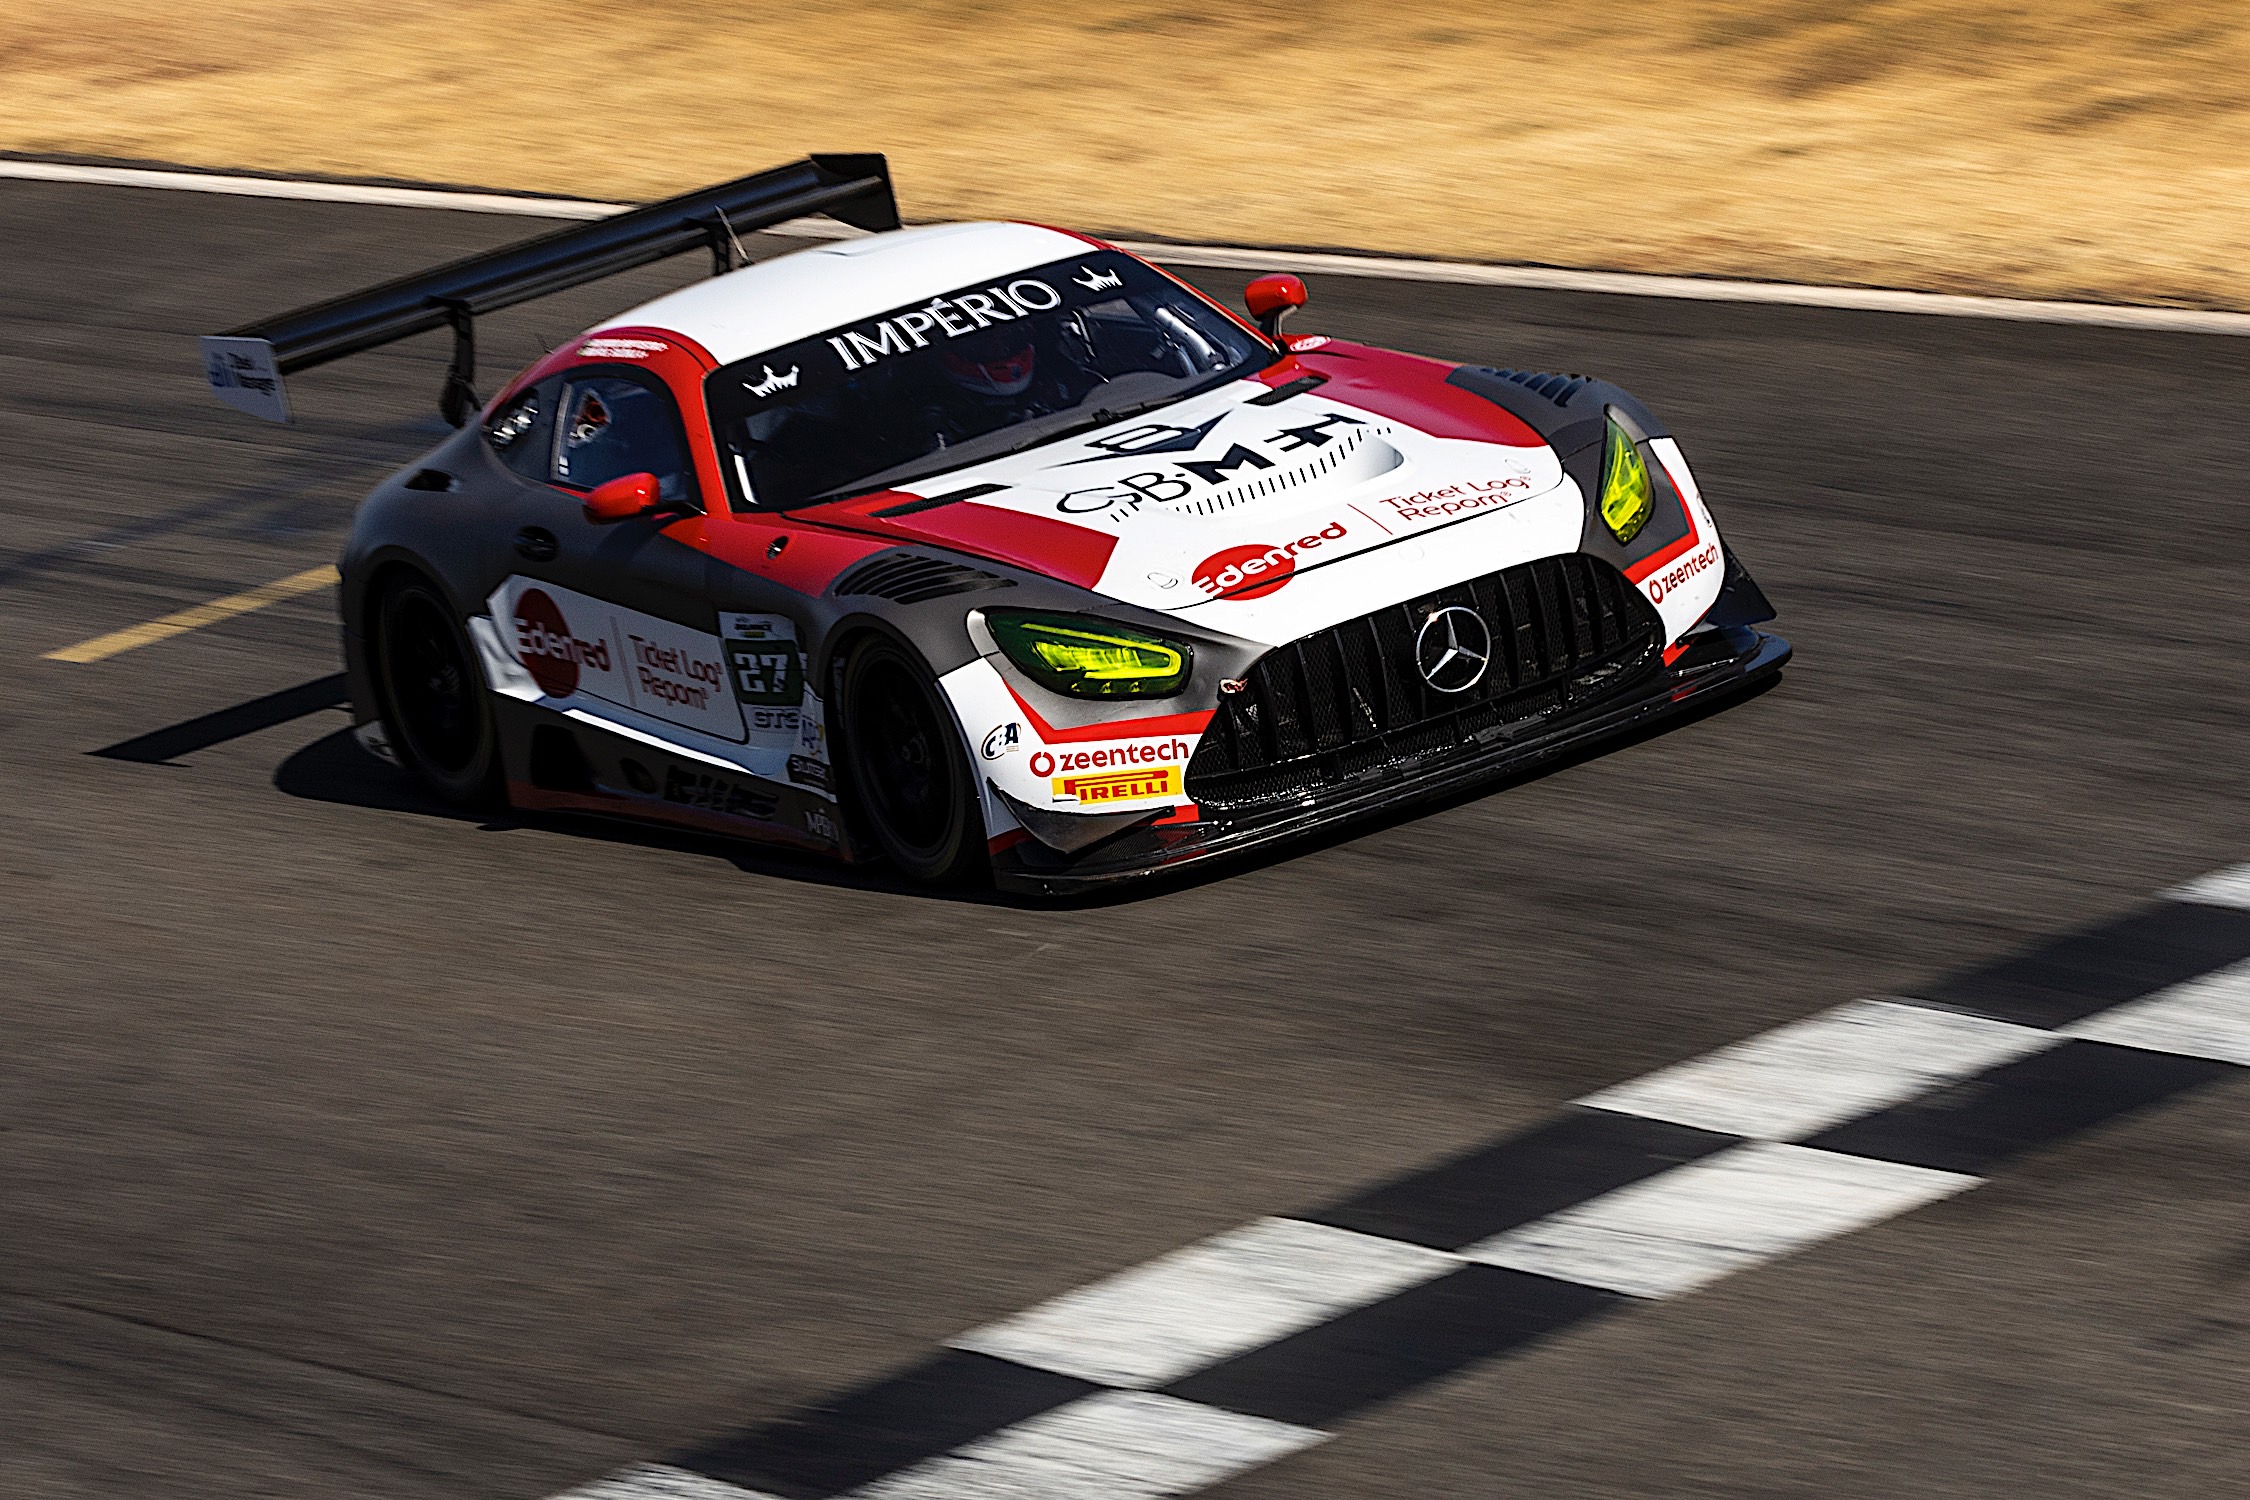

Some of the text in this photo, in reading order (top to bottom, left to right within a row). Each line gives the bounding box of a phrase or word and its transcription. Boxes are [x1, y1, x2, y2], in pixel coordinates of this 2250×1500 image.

[826, 279, 1061, 370] IMPÉRIO
[1379, 484, 1466, 509] Ticket
[1195, 522, 1347, 596] Edenred
[1662, 543, 1719, 593] zeentech
[514, 615, 610, 672] Edenred
[628, 634, 682, 675] Ticket
[732, 652, 788, 694] 27
[1060, 738, 1189, 772] zeentech
[1063, 769, 1169, 802] PIRELLI
